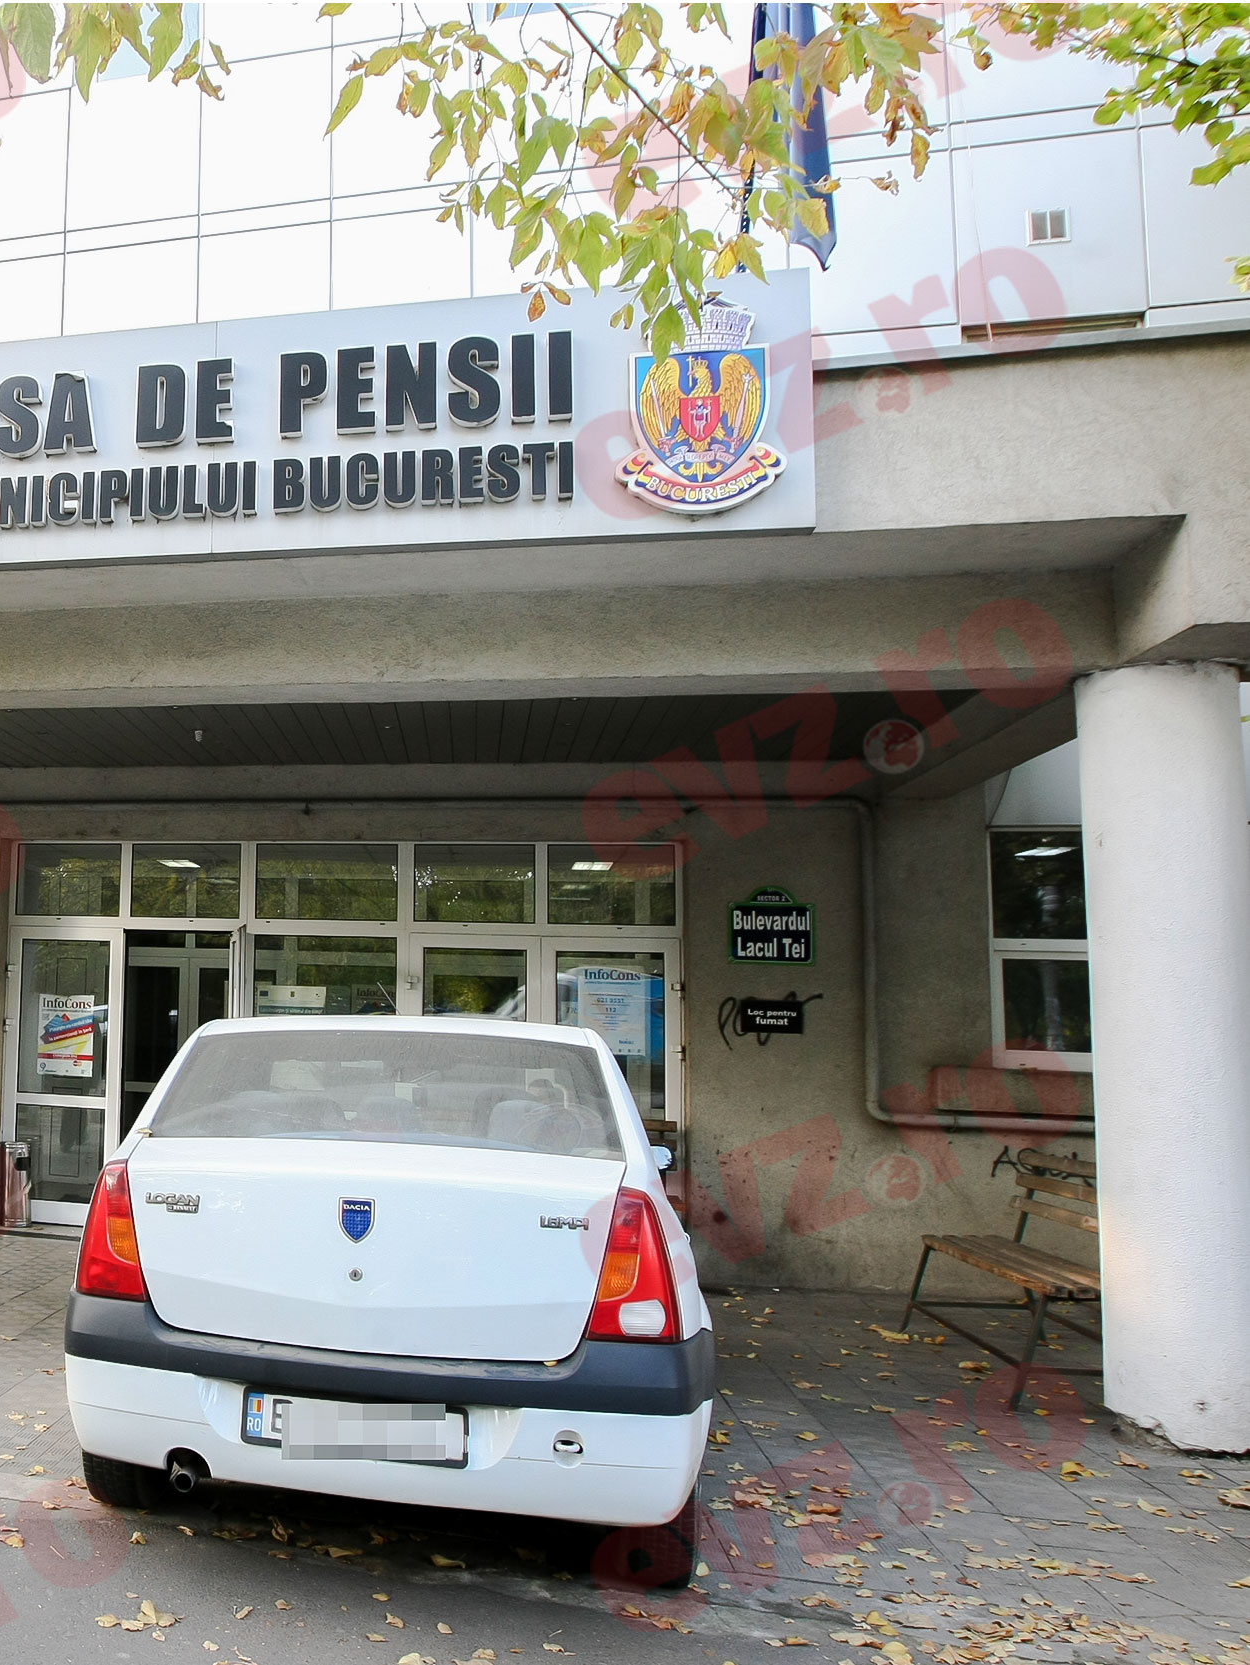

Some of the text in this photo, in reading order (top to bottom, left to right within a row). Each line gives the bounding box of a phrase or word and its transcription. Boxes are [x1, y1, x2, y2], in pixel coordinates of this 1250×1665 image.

[136, 357, 235, 449] DE
[279, 329, 573, 439] PENSII
[273, 440, 573, 514] BUCURESTI
[733, 910, 810, 931] Bulevardul
[737, 937, 805, 958] Lacul Tei
[584, 969, 641, 981] InfoCons
[42, 997, 92, 1010] InfoCons
[747, 1008, 797, 1018] Loc pentru
[755, 1016, 789, 1026] fumat
[145, 1192, 201, 1206] LOGAN
[246, 1416, 262, 1432] RO
